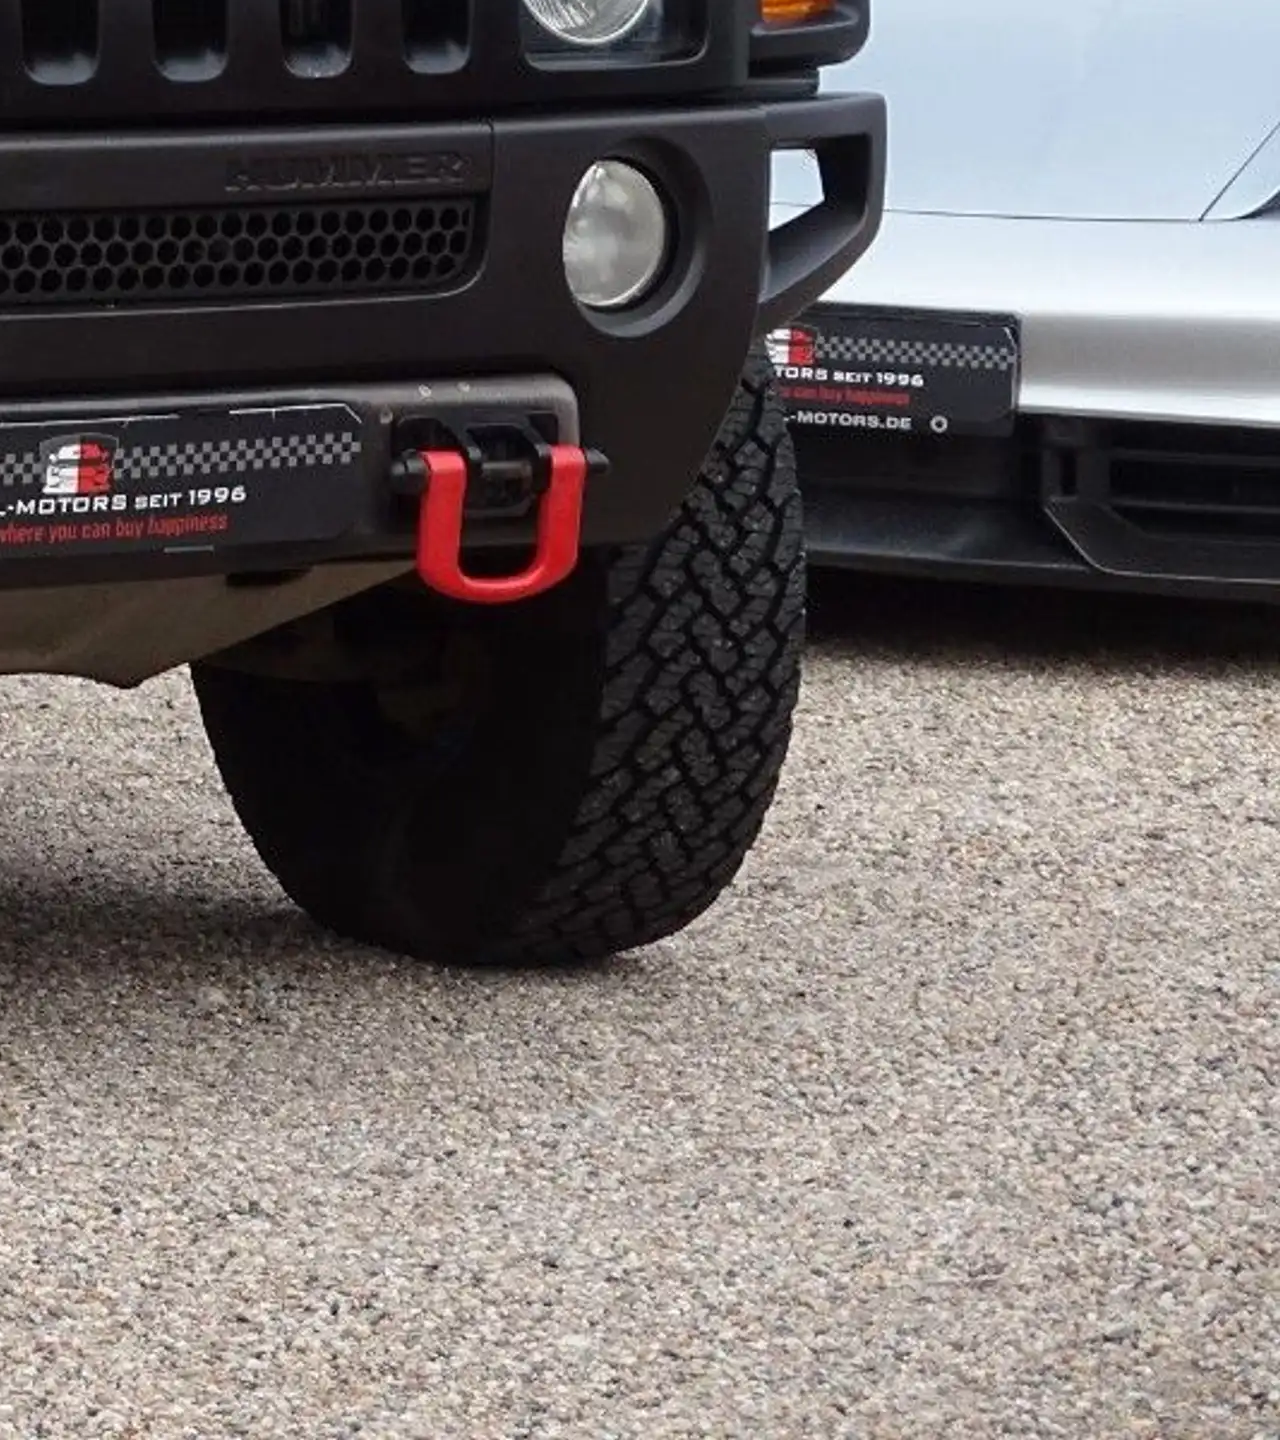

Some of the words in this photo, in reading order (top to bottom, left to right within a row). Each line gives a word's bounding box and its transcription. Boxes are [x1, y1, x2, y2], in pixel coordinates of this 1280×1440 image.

[833, 371, 873, 383] SEIT
[876, 371, 924, 387] 1996
[135, 492, 182, 510] SEIT
[189, 485, 247, 505] 1996
[48, 521, 77, 545] you
[82, 524, 111, 539] can
[115, 517, 144, 538] buy
[147, 513, 228, 538] happiness
